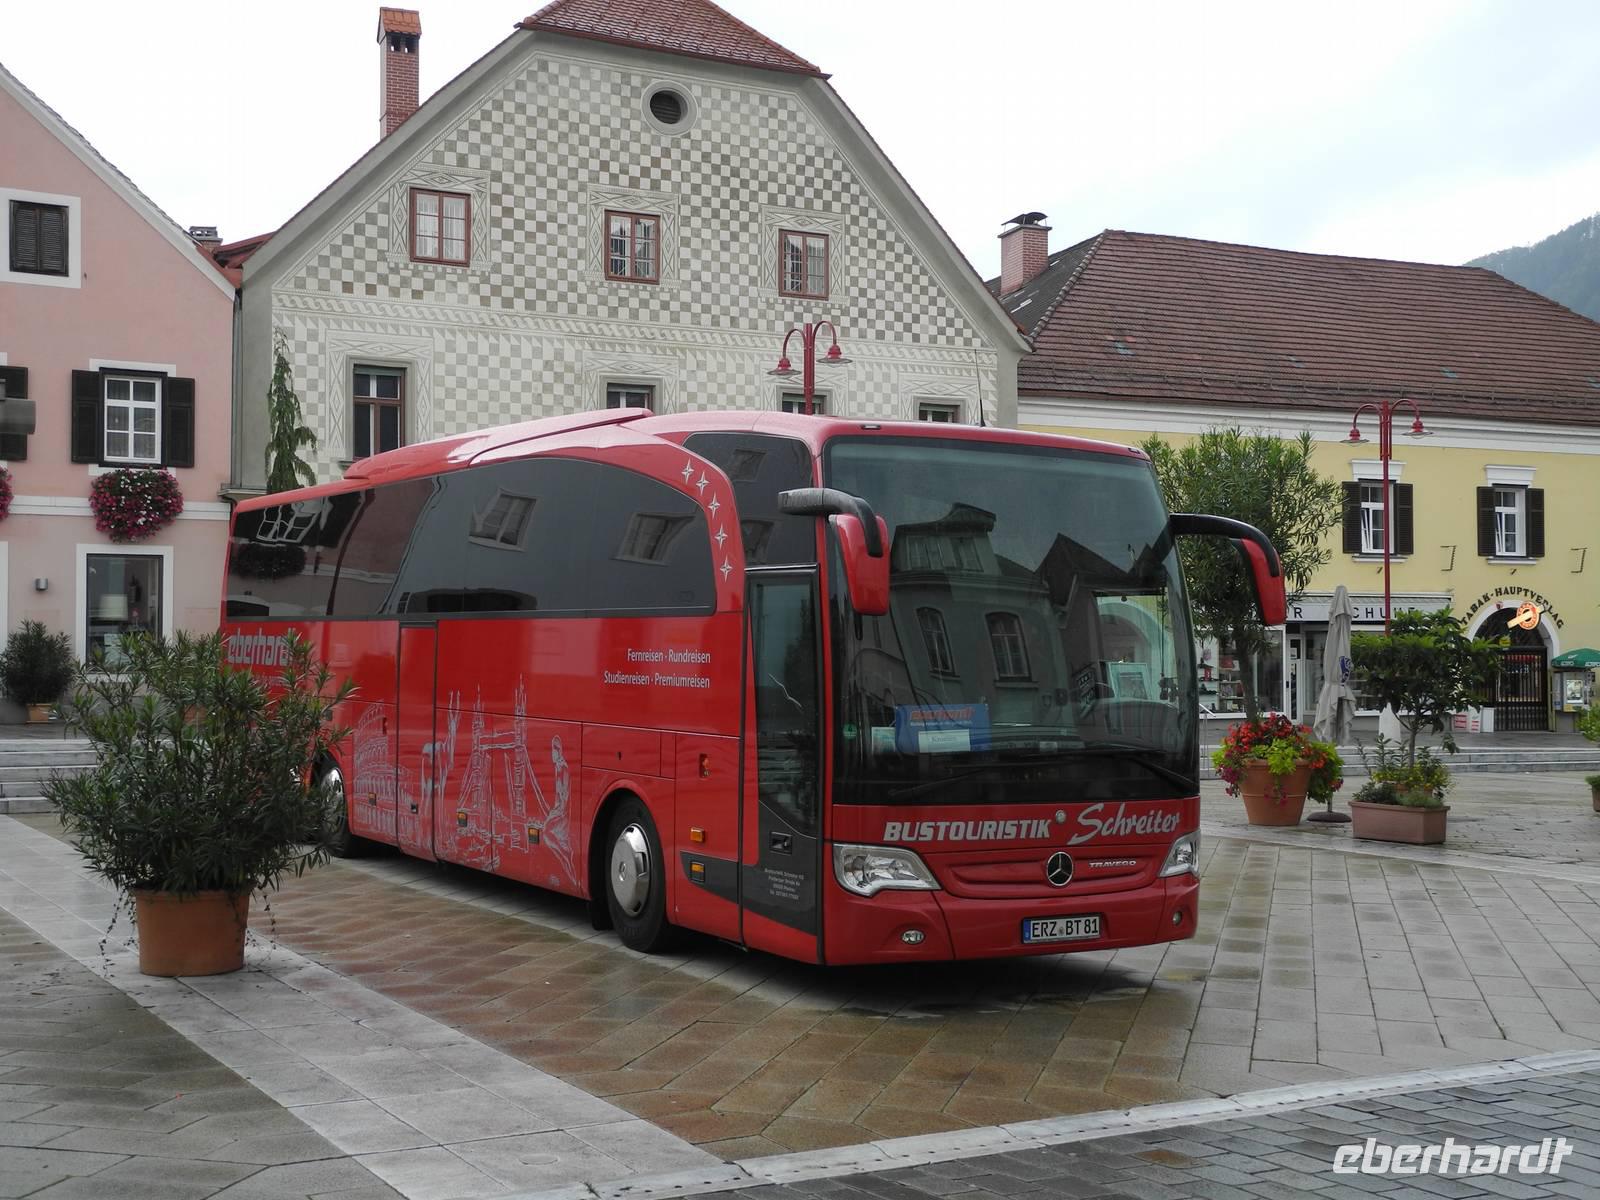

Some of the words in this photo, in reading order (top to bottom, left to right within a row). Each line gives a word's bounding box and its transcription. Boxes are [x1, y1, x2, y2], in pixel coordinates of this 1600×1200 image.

[627, 648, 664, 662] Fernreisen
[668, 649, 711, 664] Rundreisen
[604, 670, 650, 685] Studienreisen
[654, 672, 710, 689] Premiumreisen
[883, 819, 1051, 842] BUSTOURISTIK
[1067, 802, 1180, 846] Schreiter
[1089, 860, 1137, 868] TRAVEGO
[1032, 921, 1057, 938] ERZ
[1065, 919, 1082, 936] BT
[1084, 918, 1099, 934] 81
